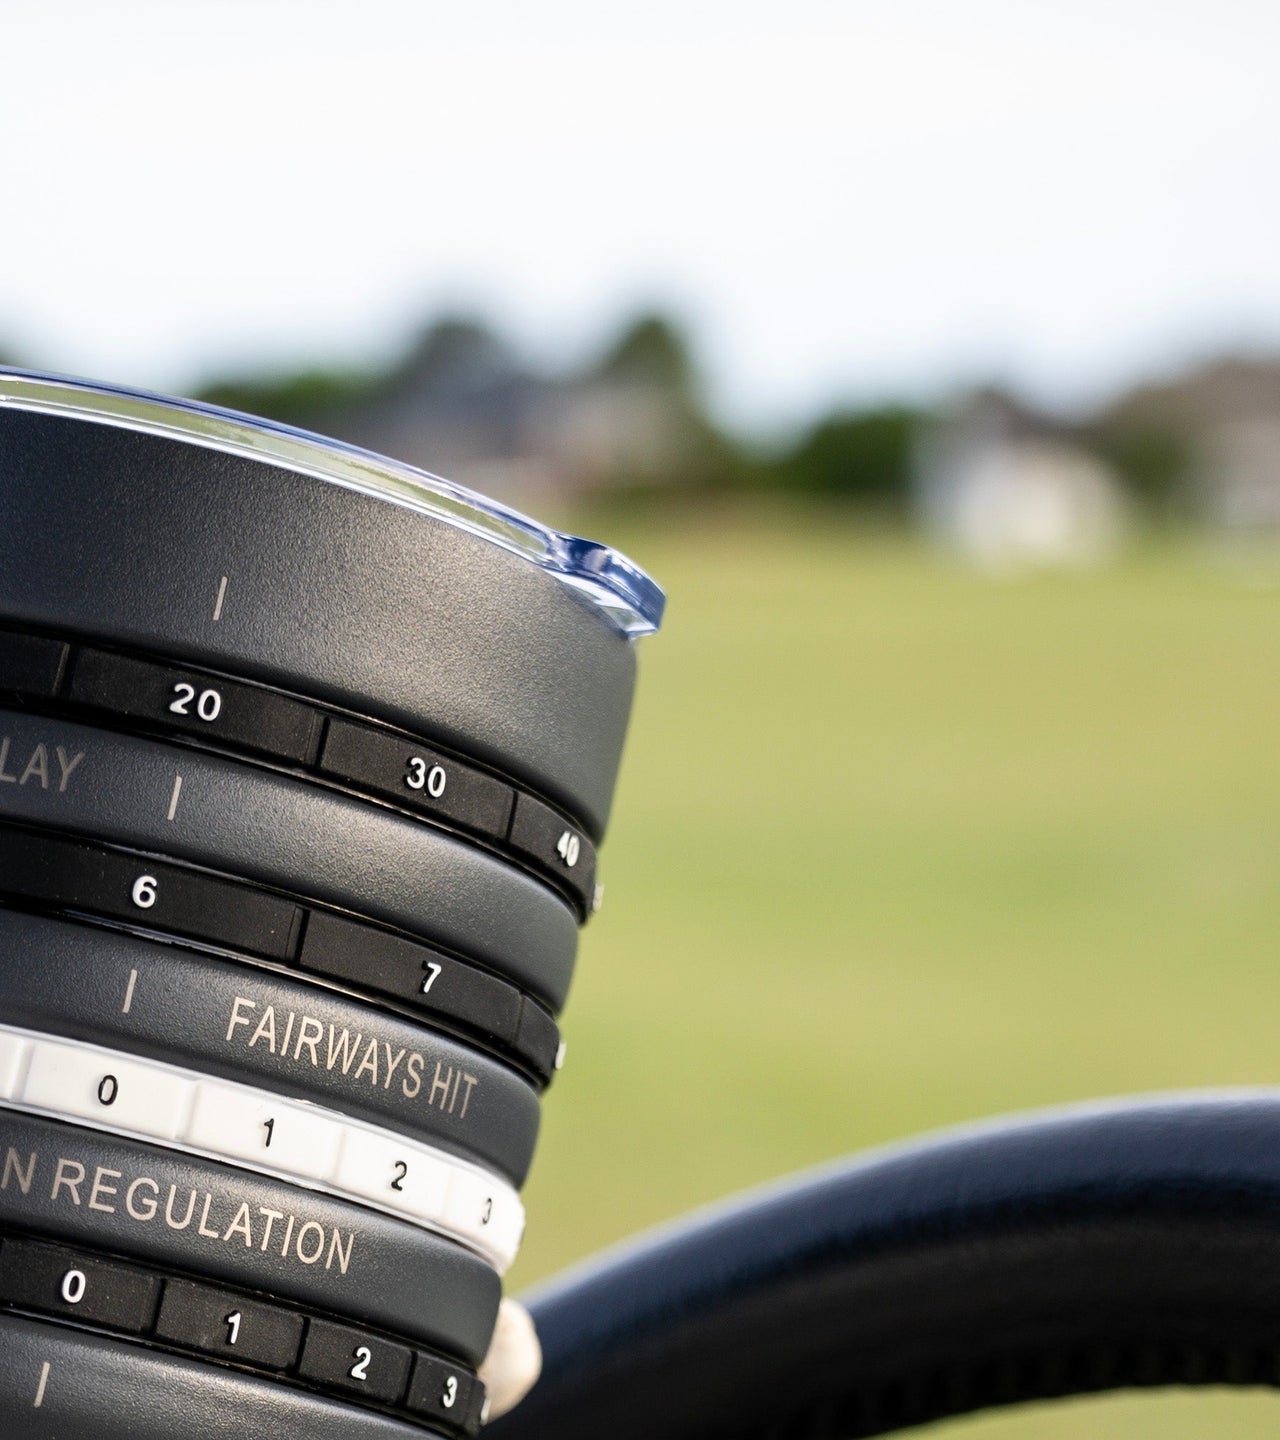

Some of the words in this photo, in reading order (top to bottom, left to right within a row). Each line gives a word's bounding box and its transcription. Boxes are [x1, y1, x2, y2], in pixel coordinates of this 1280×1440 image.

[168, 682, 222, 722] 20
[406, 756, 447, 798] 30
[557, 830, 581, 868] 40
[132, 875, 158, 909] 6
[421, 961, 443, 993] 7
[225, 996, 426, 1099] FAIRWAYS
[427, 1061, 479, 1118] HIT
[97, 1074, 119, 1106] 0
[262, 1118, 275, 1148] 1
[389, 1160, 409, 1192] 2
[482, 1197, 494, 1226] 3
[51, 1158, 355, 1274] REGULATION
[61, 1269, 87, 1304] 0
[225, 1311, 241, 1344] 1
[350, 1346, 373, 1380] 2
[442, 1375, 458, 1408] 3
